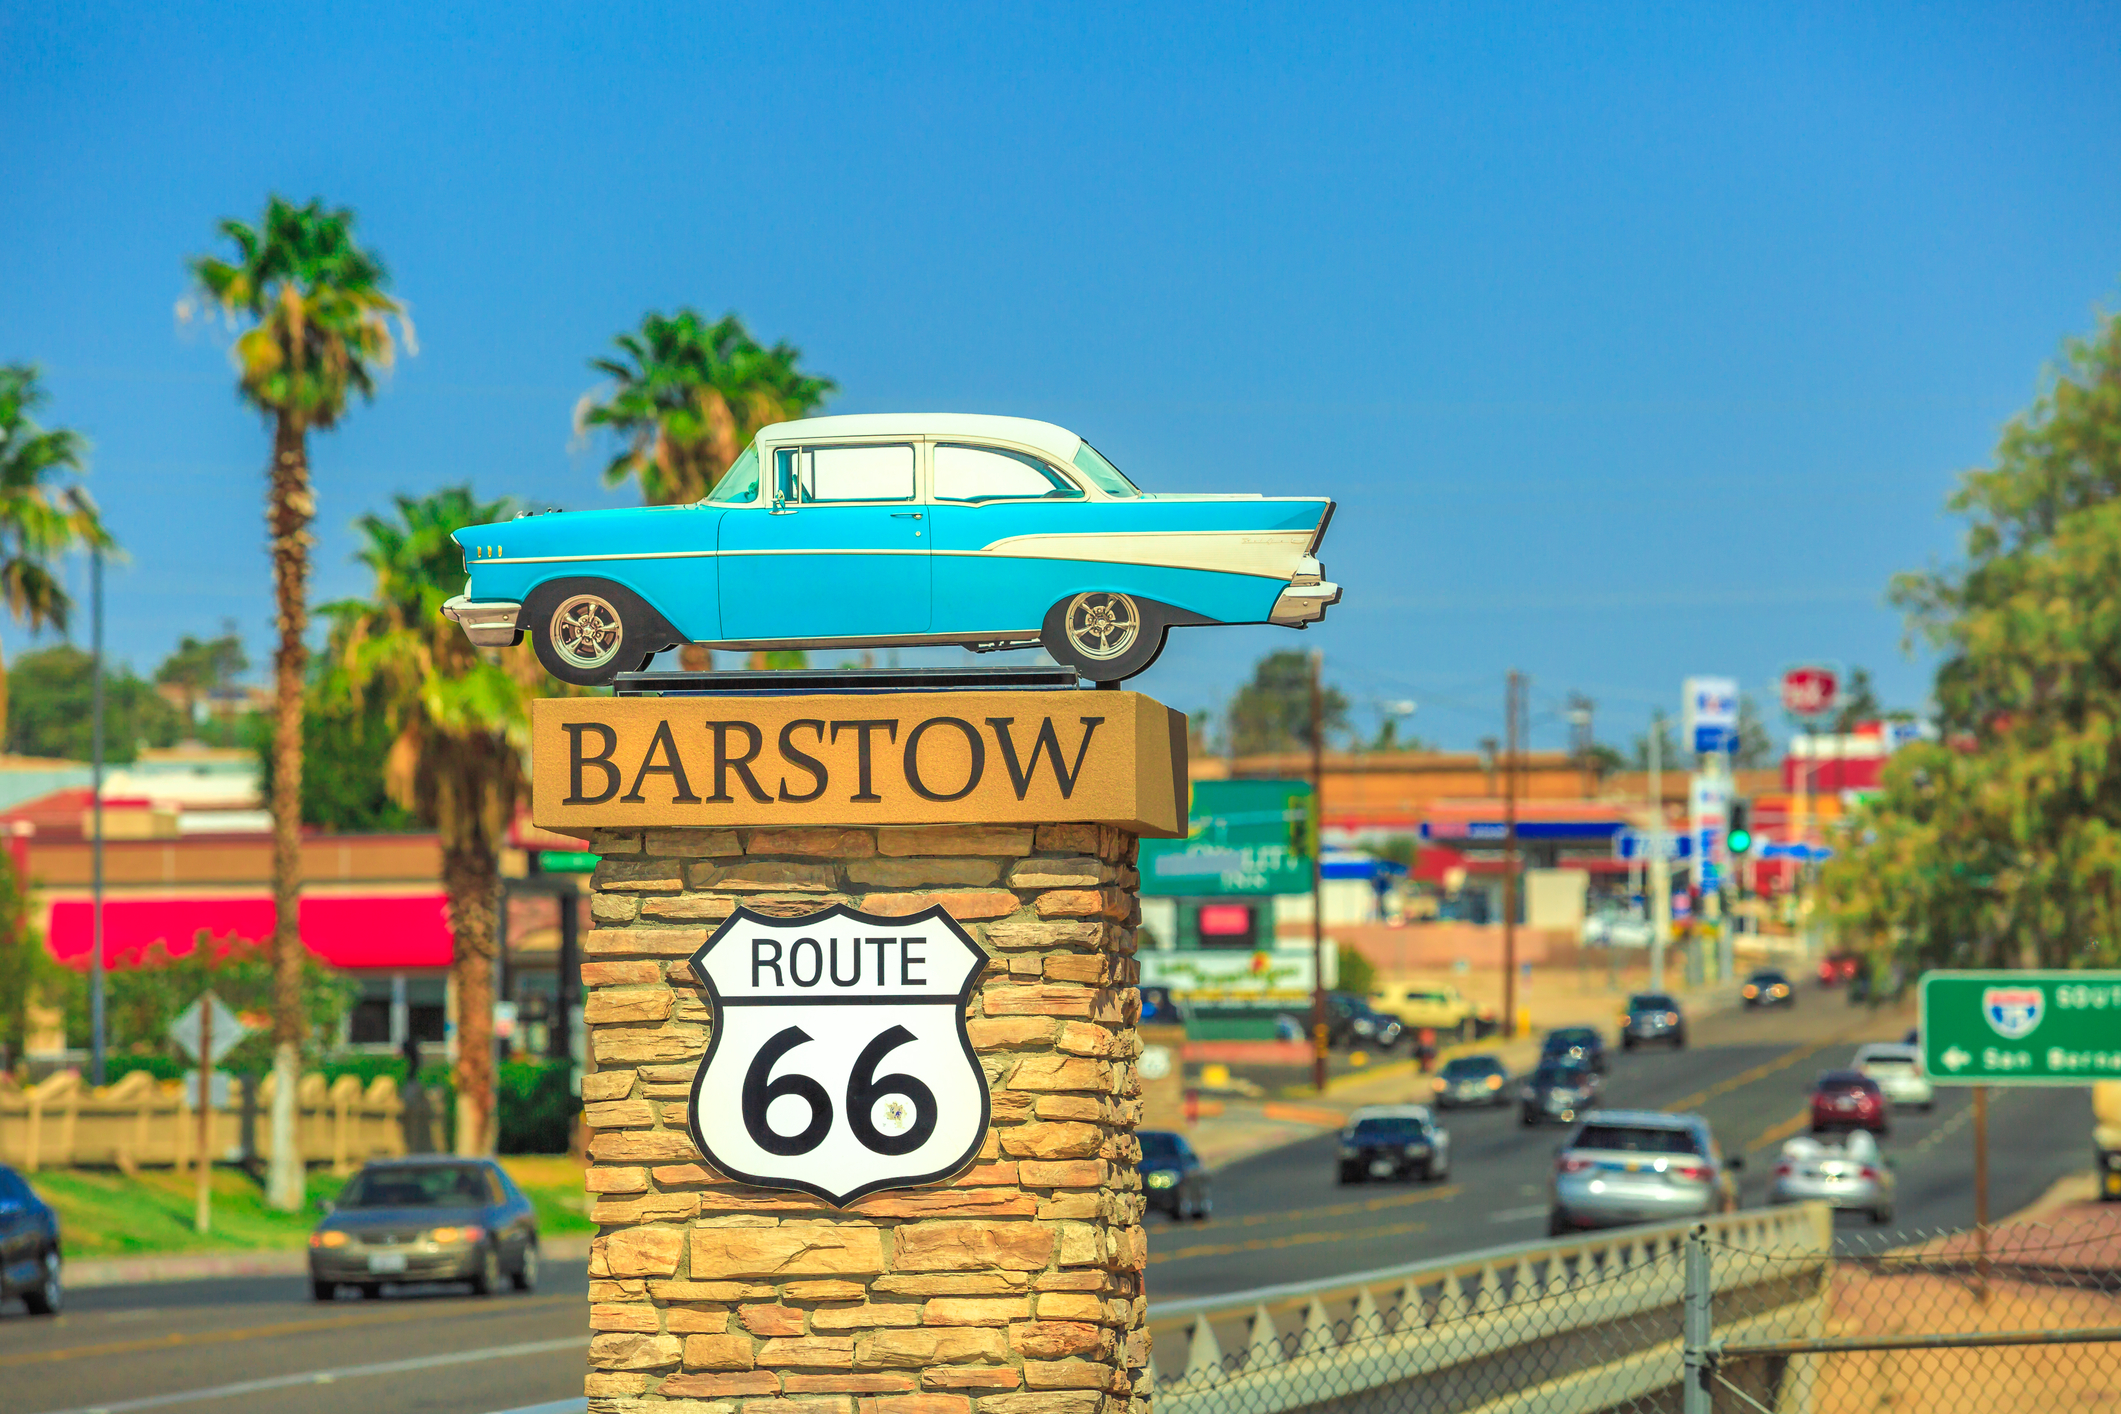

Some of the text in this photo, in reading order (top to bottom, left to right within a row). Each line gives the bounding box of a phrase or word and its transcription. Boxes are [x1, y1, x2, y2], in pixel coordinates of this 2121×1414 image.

[562, 716, 1106, 805] BARSTOW
[752, 937, 927, 988] ROUTE
[742, 1024, 938, 1156] 66
[1983, 1047, 2031, 1070] San
